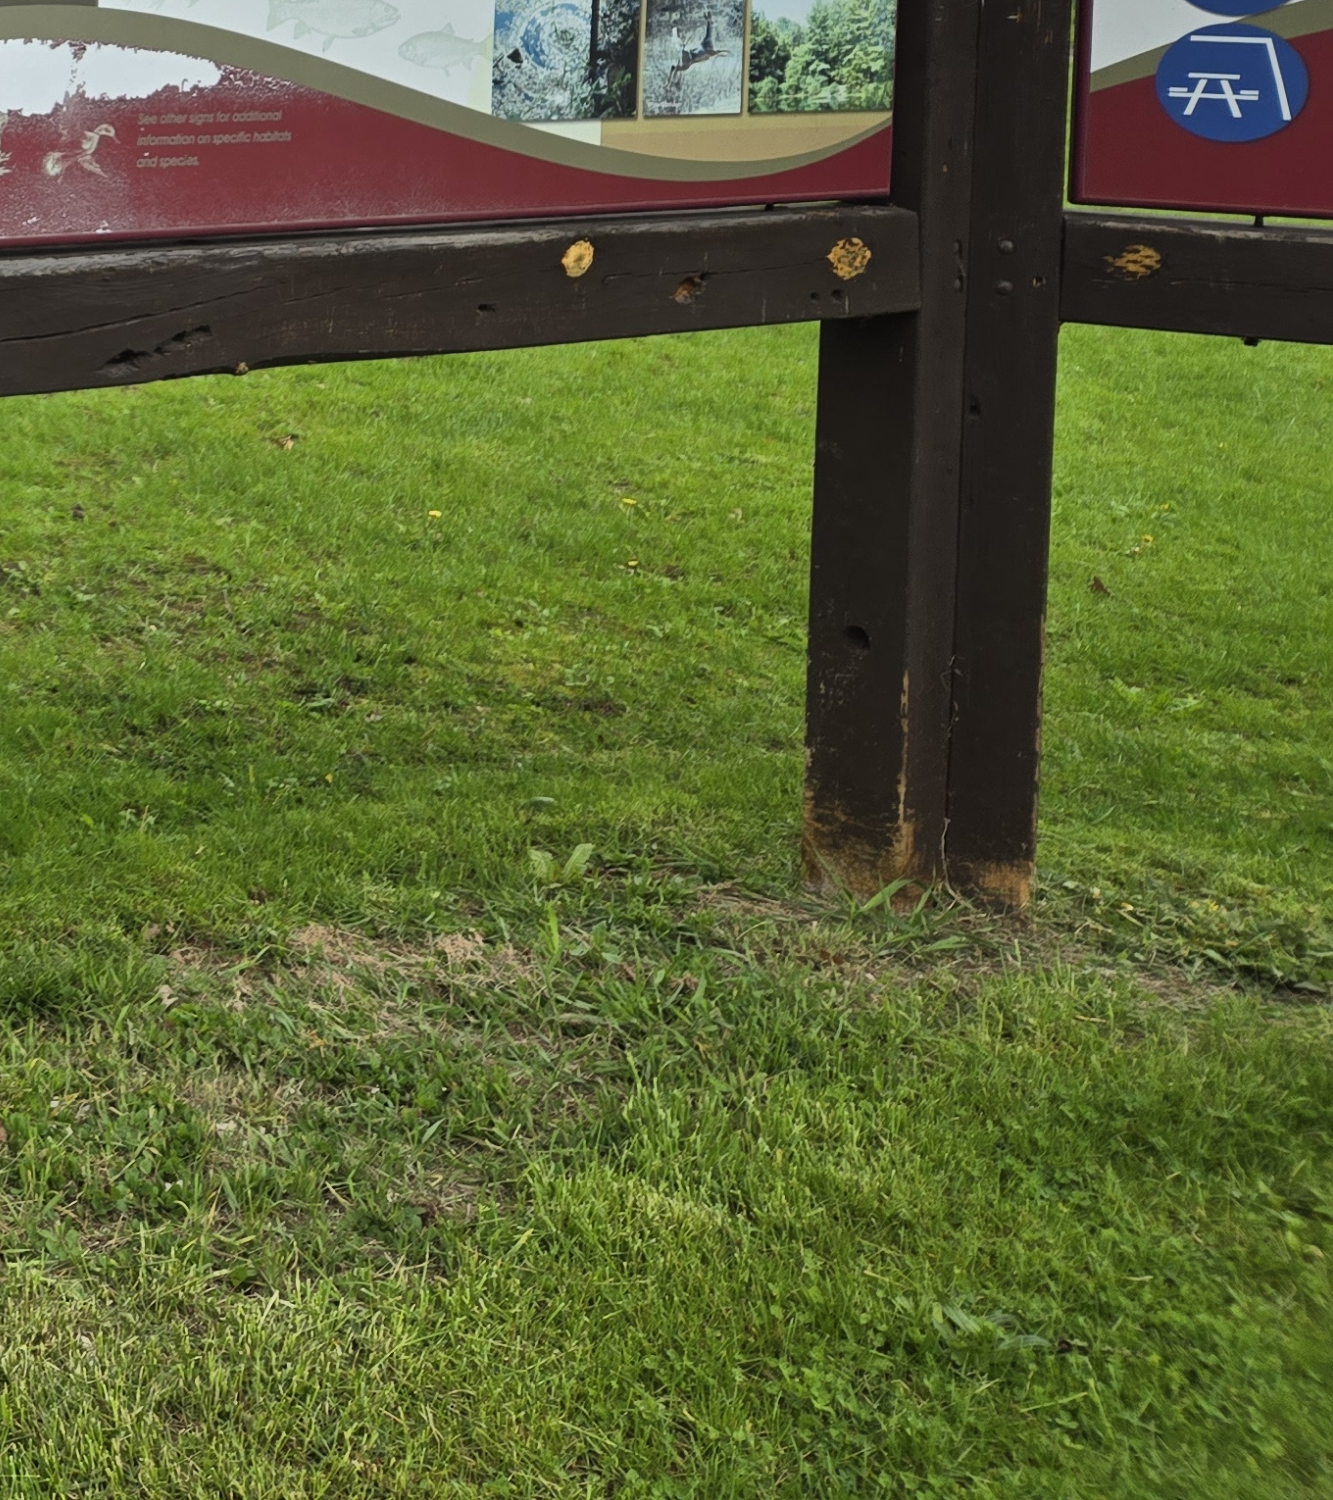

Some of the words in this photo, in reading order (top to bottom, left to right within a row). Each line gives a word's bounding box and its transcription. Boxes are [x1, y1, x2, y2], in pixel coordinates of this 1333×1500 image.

[137, 112, 157, 125] See
[159, 112, 187, 125] other
[188, 111, 214, 125] signs
[215, 111, 231, 122] for
[232, 110, 283, 122] additional
[136, 133, 195, 145] information
[196, 134, 210, 144] on
[211, 130, 251, 145] specific
[252, 130, 291, 141] habitats
[136, 155, 157, 168] and
[159, 154, 199, 168] species.
